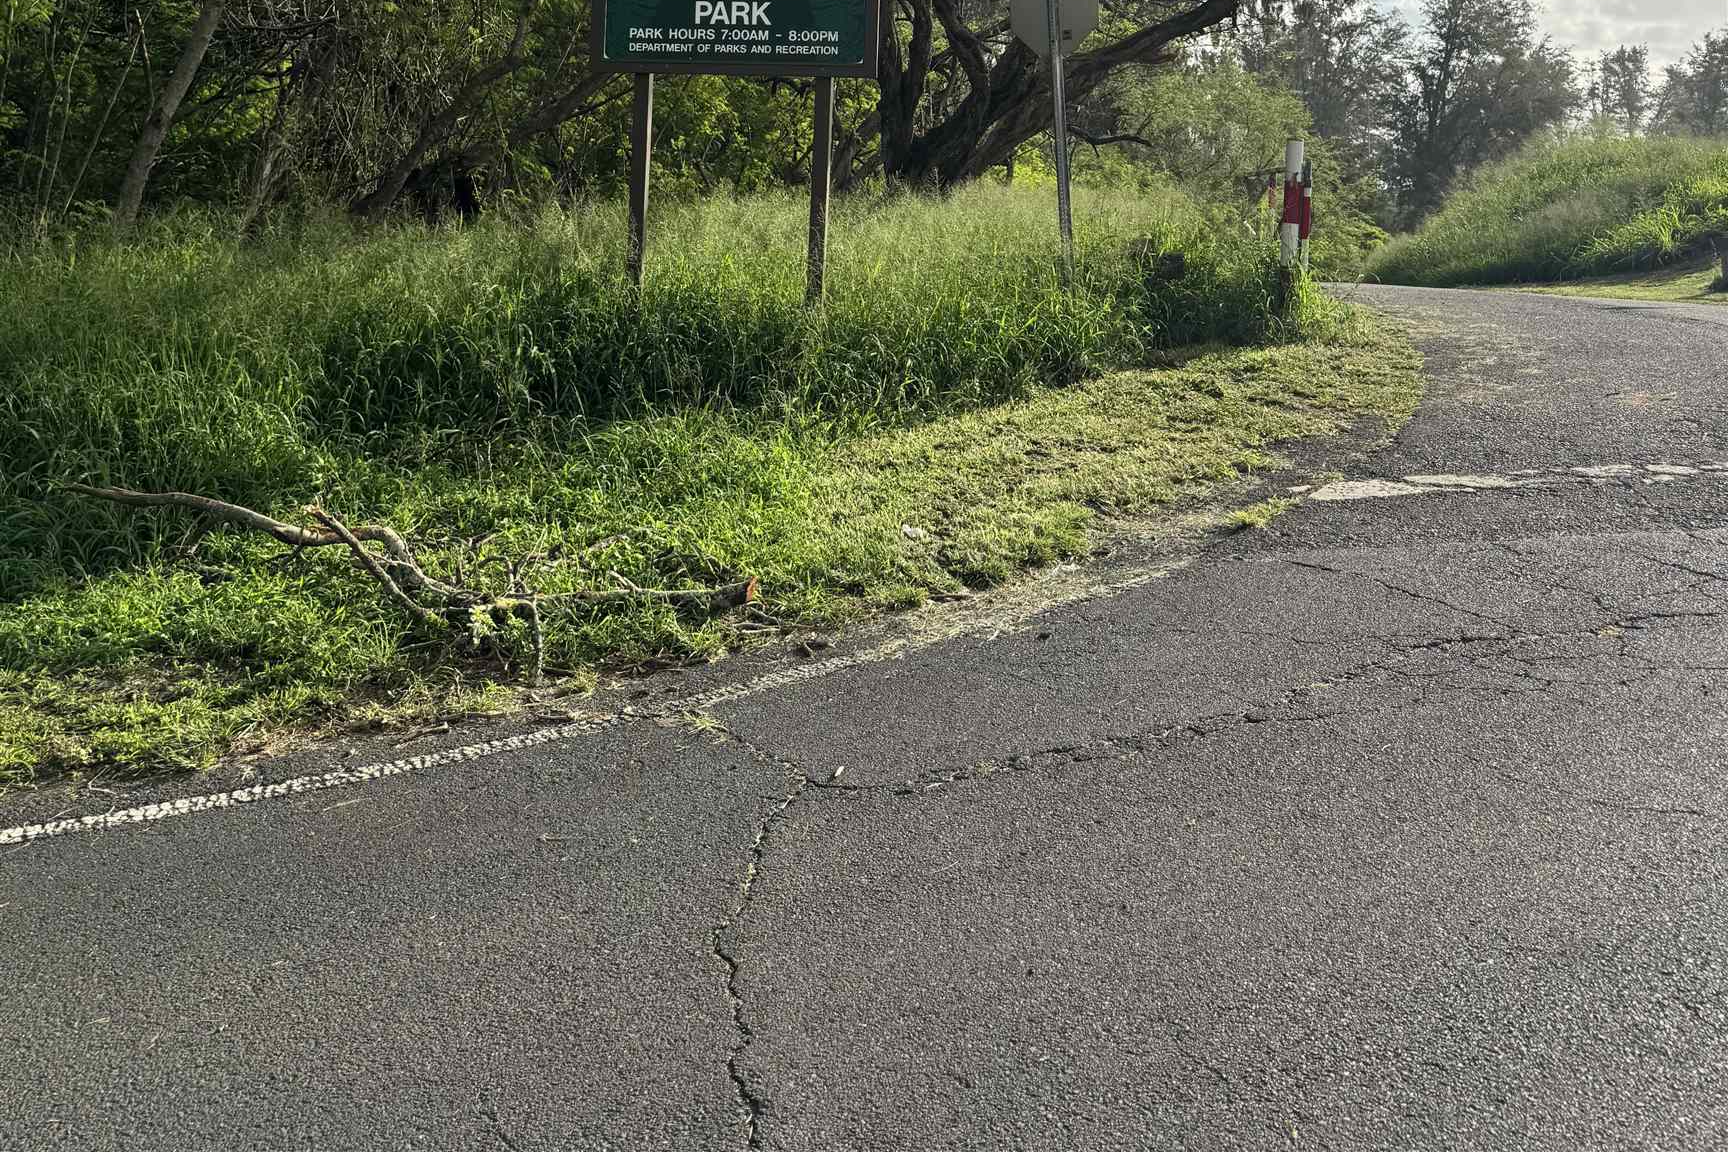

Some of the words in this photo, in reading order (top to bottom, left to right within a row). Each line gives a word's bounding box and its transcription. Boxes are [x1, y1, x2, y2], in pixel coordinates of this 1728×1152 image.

[695, 1, 772, 25] PARK
[629, 28, 663, 39] PARK
[669, 28, 716, 40] HOURS
[721, 29, 769, 41] 7:00AM
[788, 30, 839, 42] 8:00PM
[629, 42, 694, 53] DEPARTMENT
[697, 44, 711, 53] OF
[714, 44, 747, 54] PARKS
[751, 45, 771, 54] AND
[775, 45, 838, 55] RECREATION
